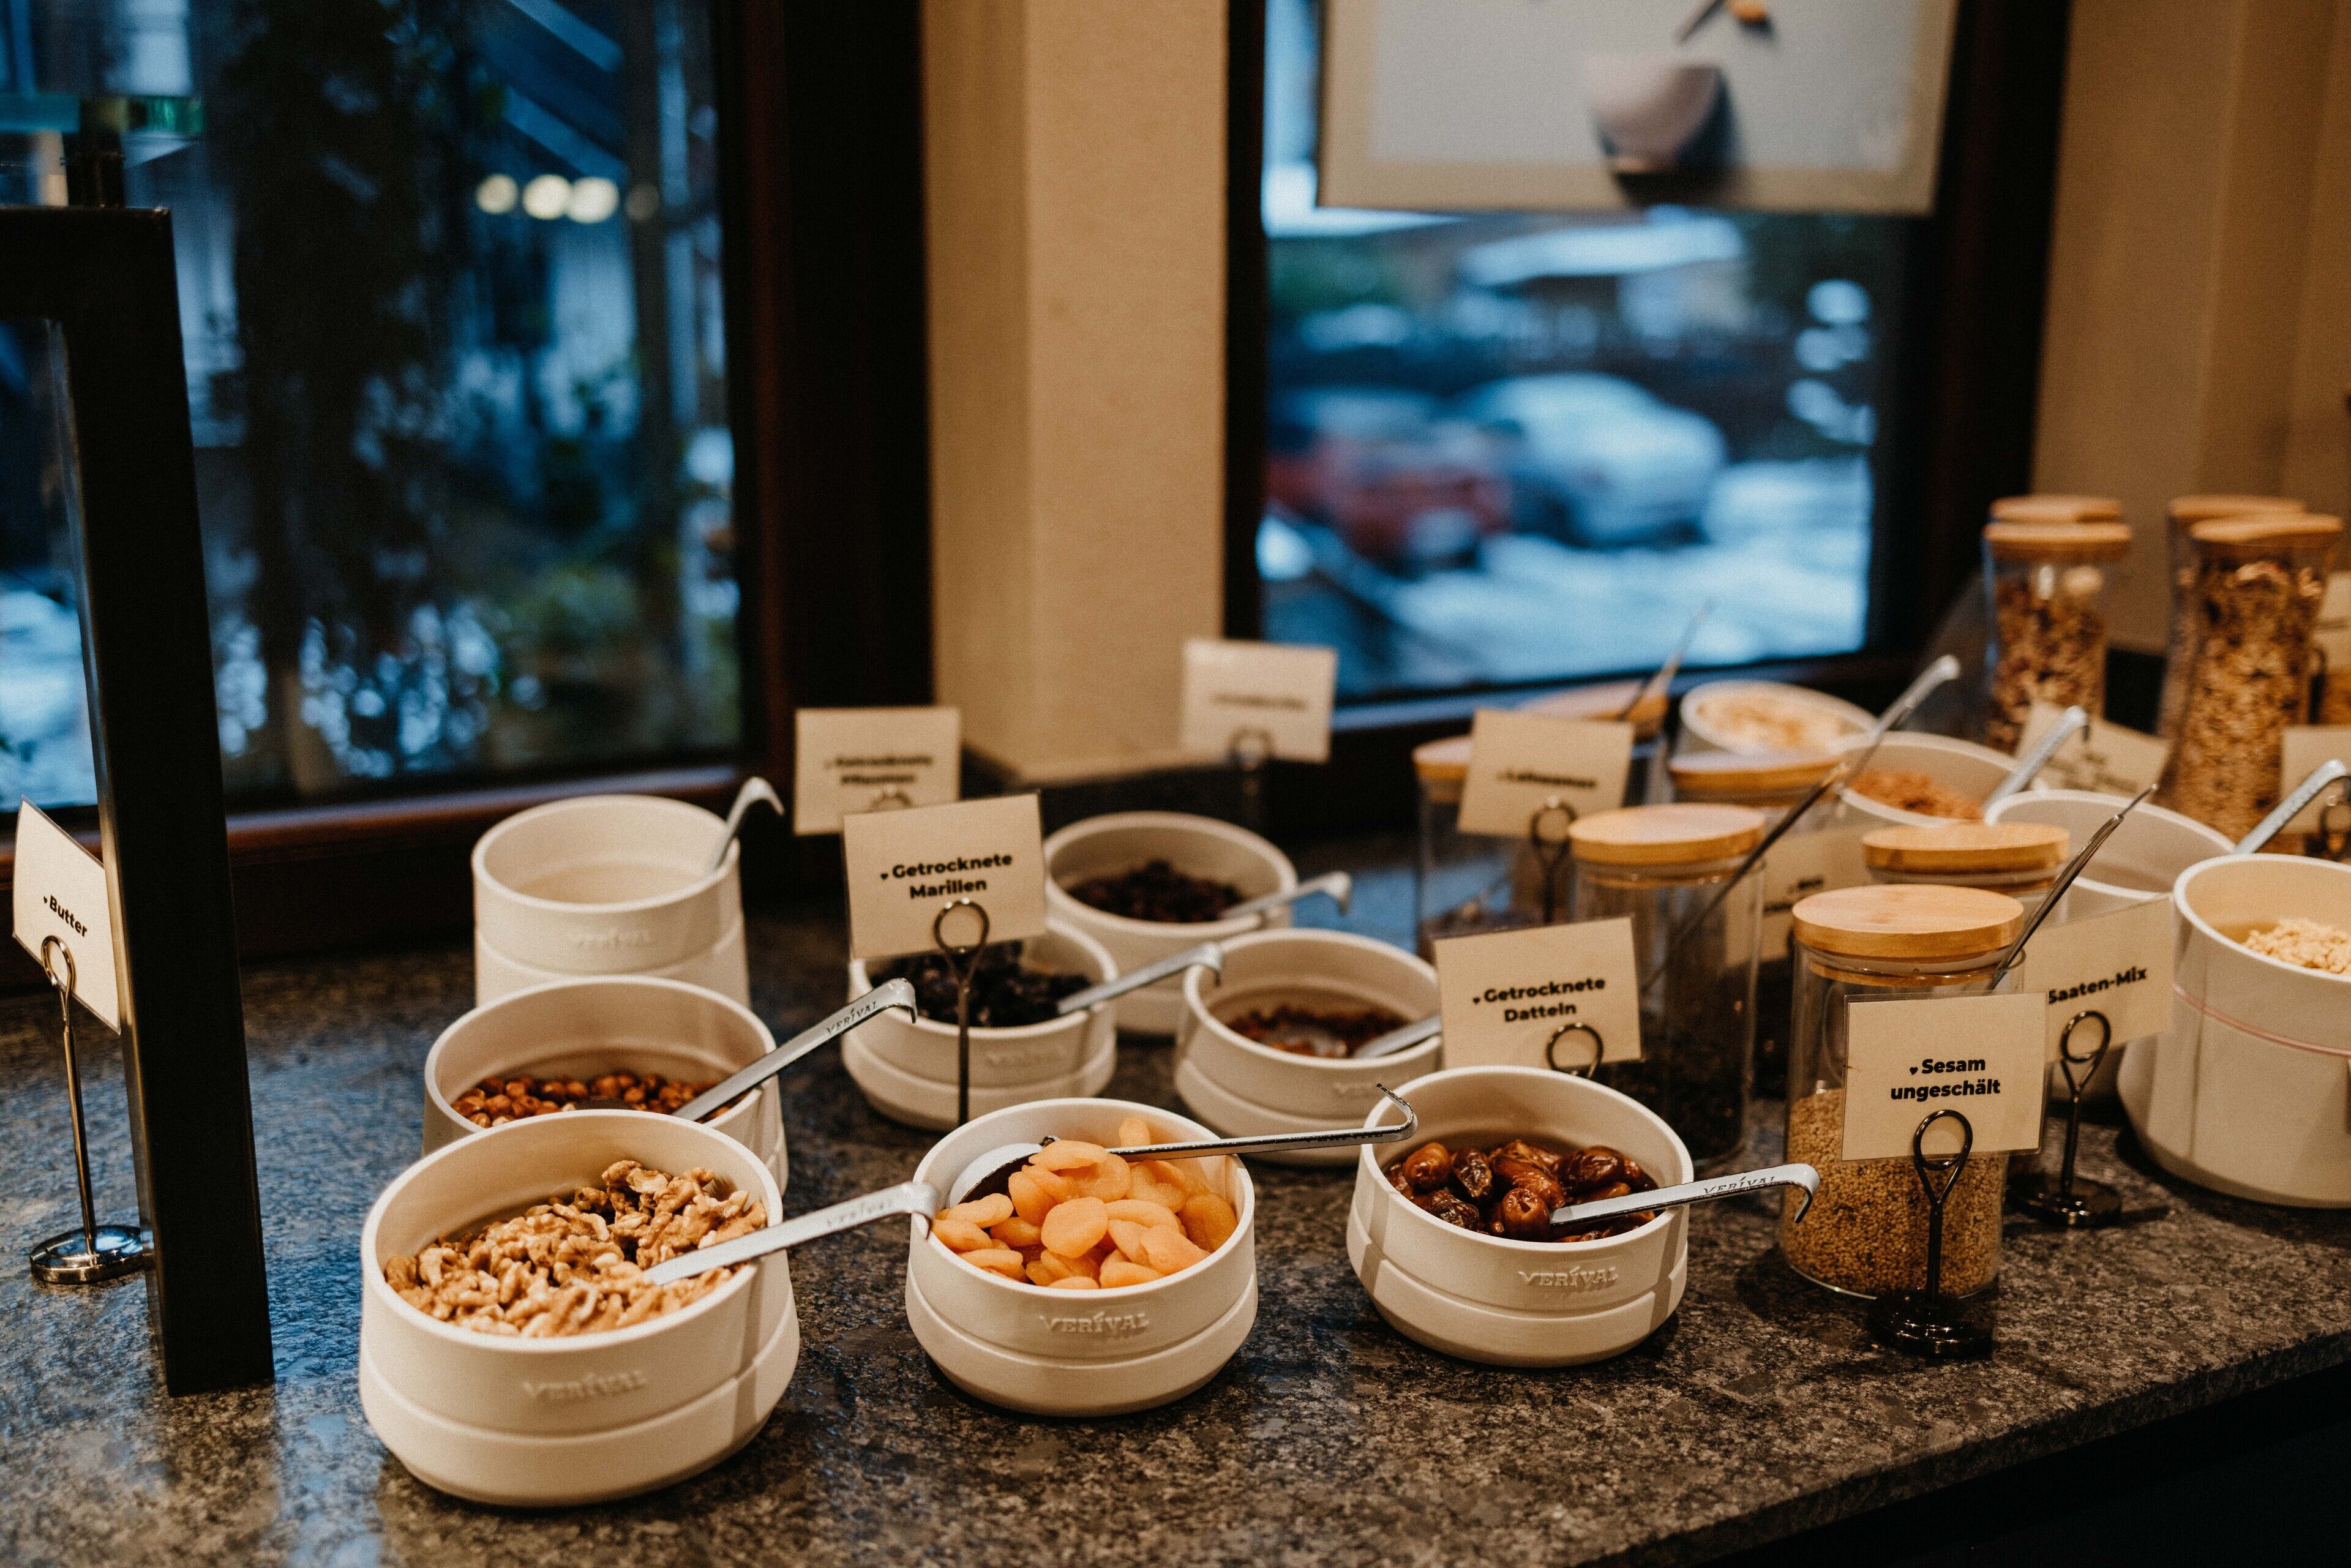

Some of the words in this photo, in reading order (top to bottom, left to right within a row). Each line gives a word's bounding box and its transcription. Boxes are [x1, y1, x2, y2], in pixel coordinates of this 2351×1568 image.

[892, 854, 1013, 879] Getrocknete
[910, 878, 988, 899] Marillen
[49, 895, 88, 937] Butter
[1484, 978, 1606, 1003] Getrocknete
[2049, 966, 2147, 1004] Saaten-Mix
[1505, 1002, 1577, 1022] Datteln
[1921, 1058, 1986, 1075] Sesam
[1891, 1078, 2001, 1102] ungeschält
